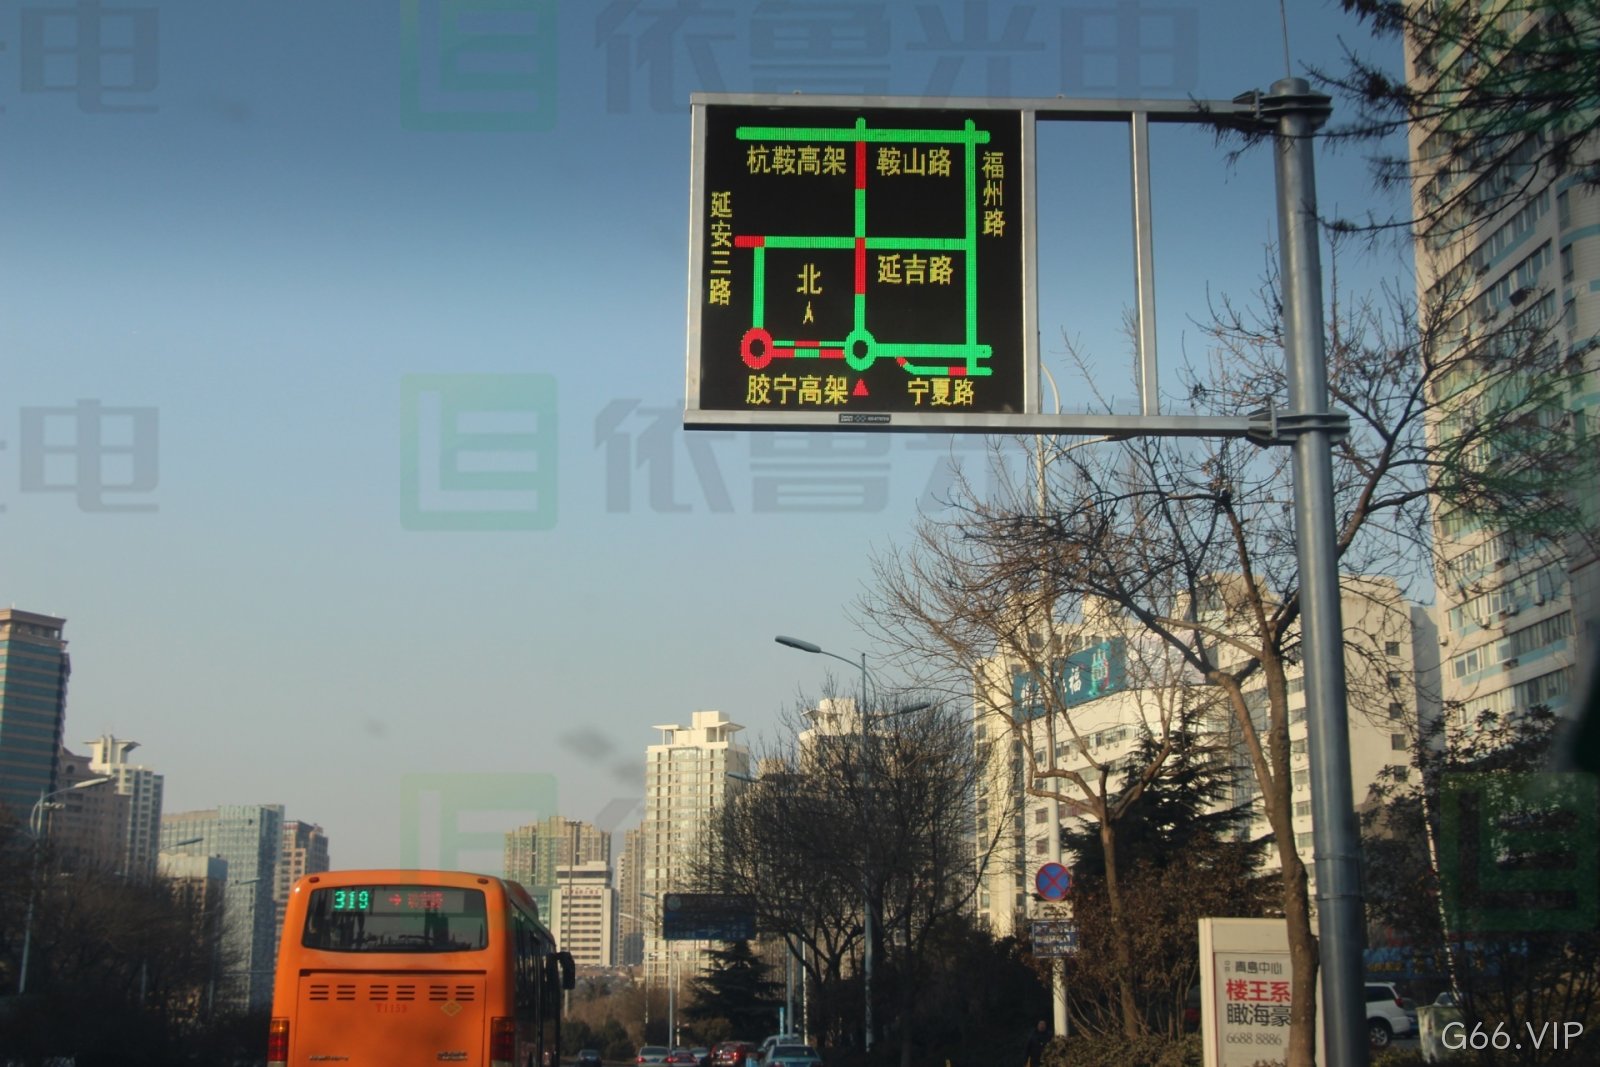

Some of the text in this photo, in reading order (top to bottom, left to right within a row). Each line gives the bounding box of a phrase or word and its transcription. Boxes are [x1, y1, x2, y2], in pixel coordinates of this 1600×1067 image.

[746, 145, 846, 175] 杭鞍高架
[876, 147, 952, 177] 鞍山路
[982, 152, 1006, 237] 福州路
[709, 191, 733, 306] 延安三路
[796, 263, 823, 295] 北
[877, 254, 954, 285] 延吉路
[745, 373, 849, 406] 胶宁高架
[907, 377, 975, 406] 宁夏路
[333, 889, 370, 910] 319
[1226, 979, 1290, 1002] 楼王系
